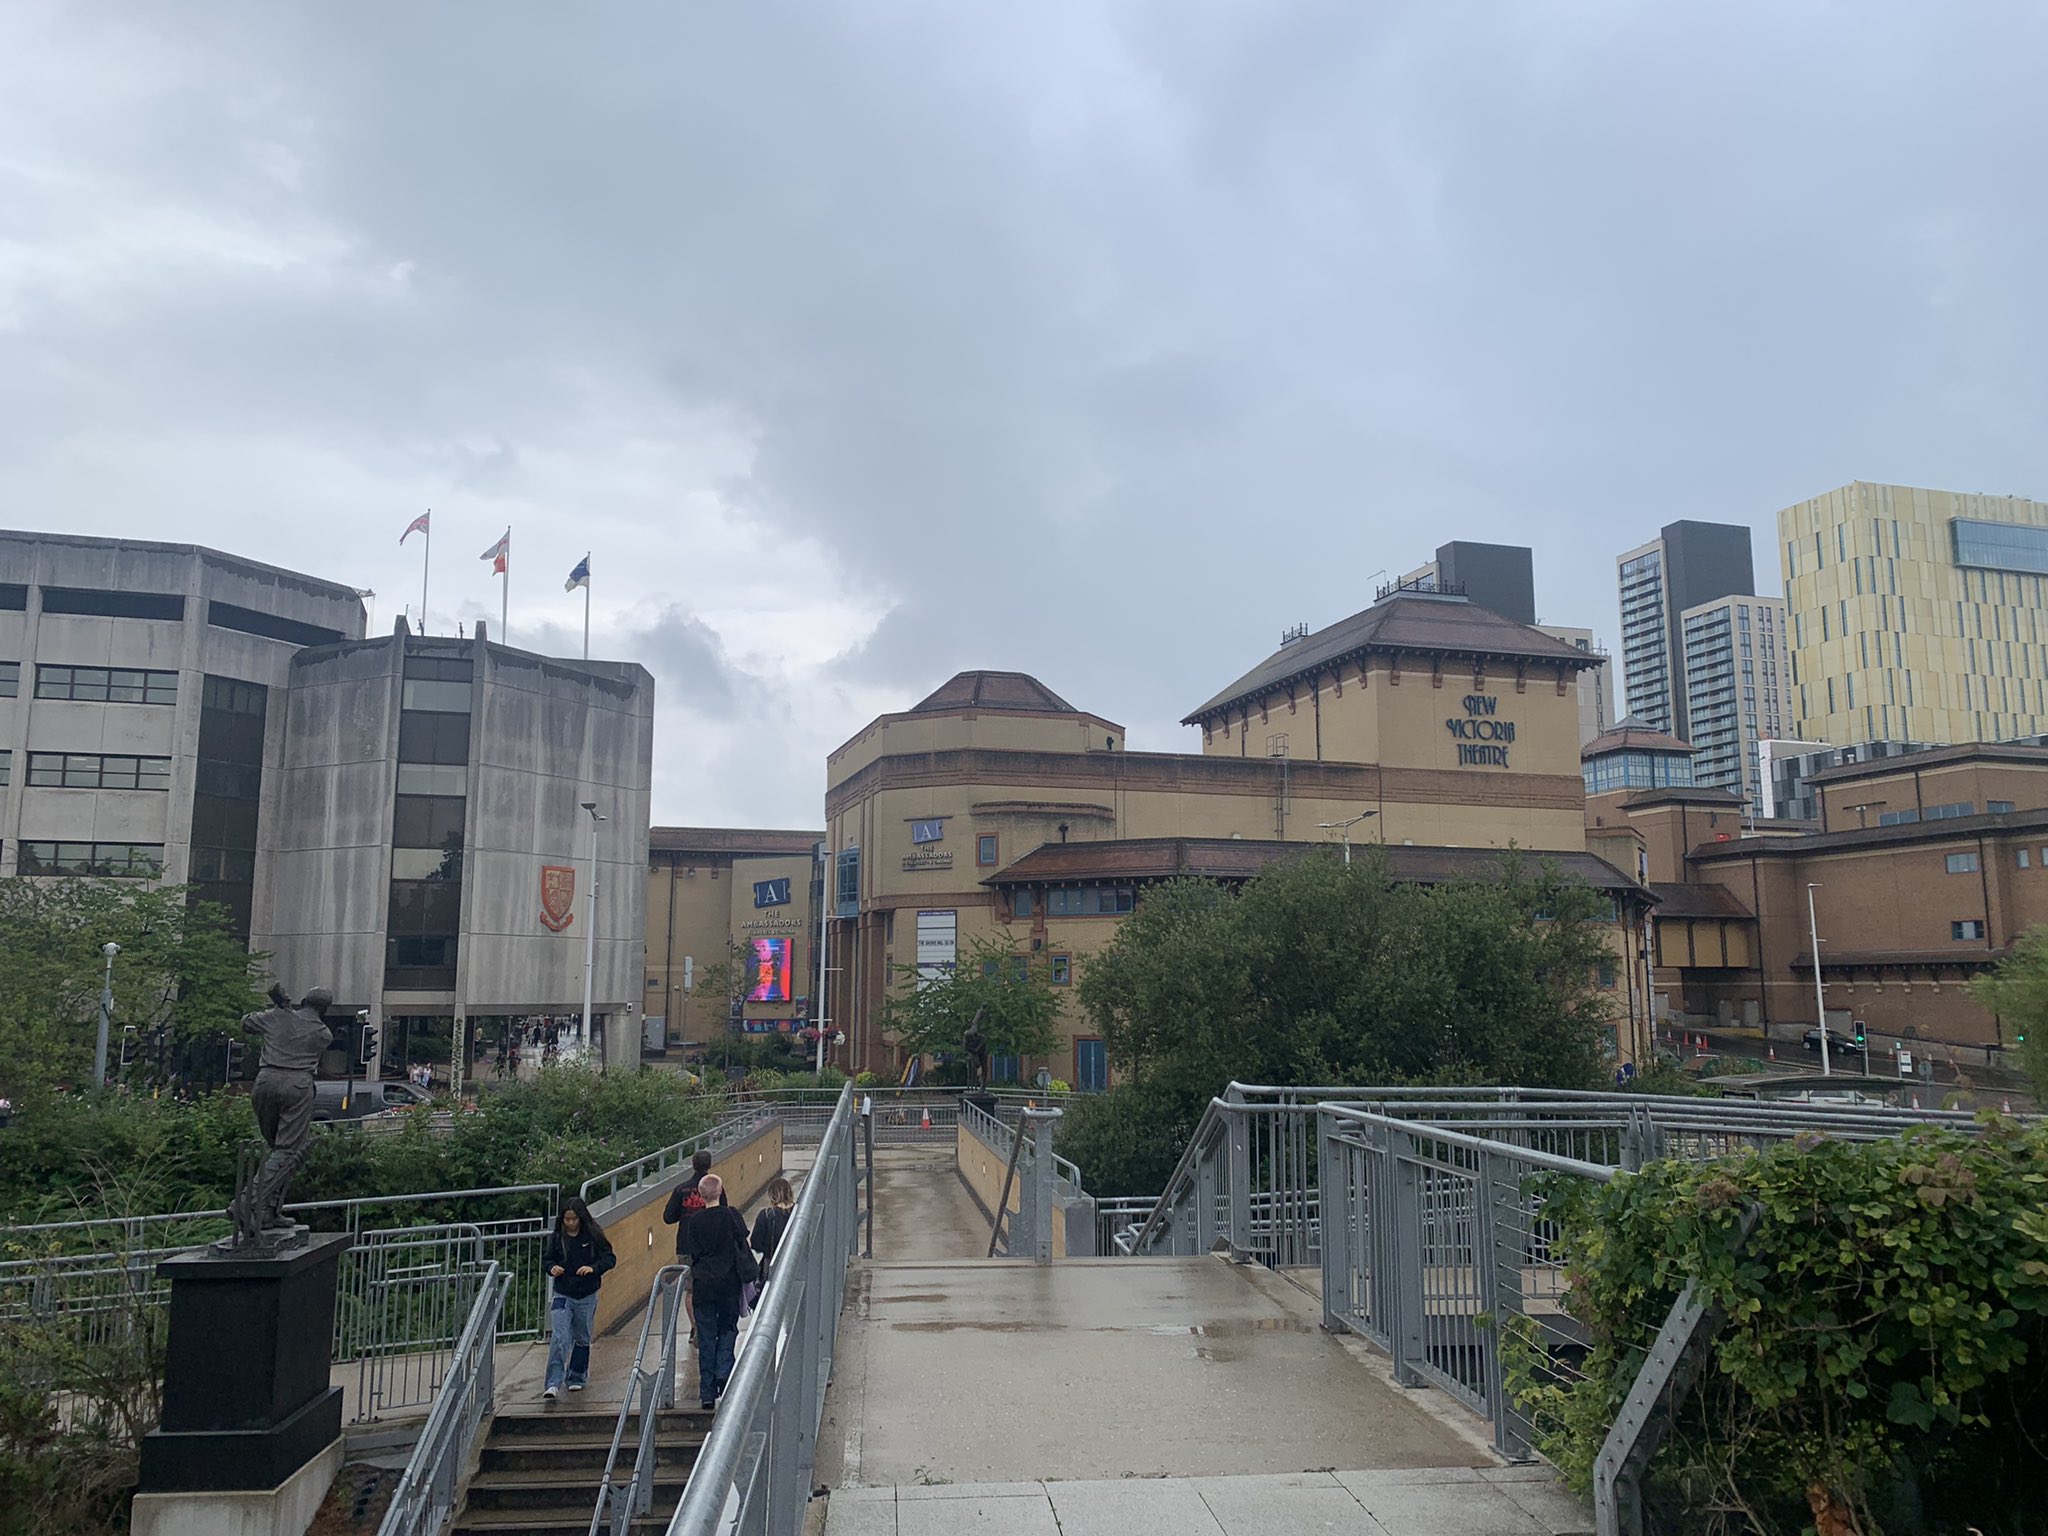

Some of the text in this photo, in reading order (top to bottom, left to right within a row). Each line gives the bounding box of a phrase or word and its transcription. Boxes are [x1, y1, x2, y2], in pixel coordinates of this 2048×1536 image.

[1463, 695, 1497, 716] NEW
[1446, 718, 1515, 743] VICTORIA
[1457, 744, 1509, 768] THEATRE
[921, 823, 932, 840] A
[764, 883, 779, 903] A
[741, 919, 802, 928] AMBASSADORS
[763, 910, 781, 918] THE
